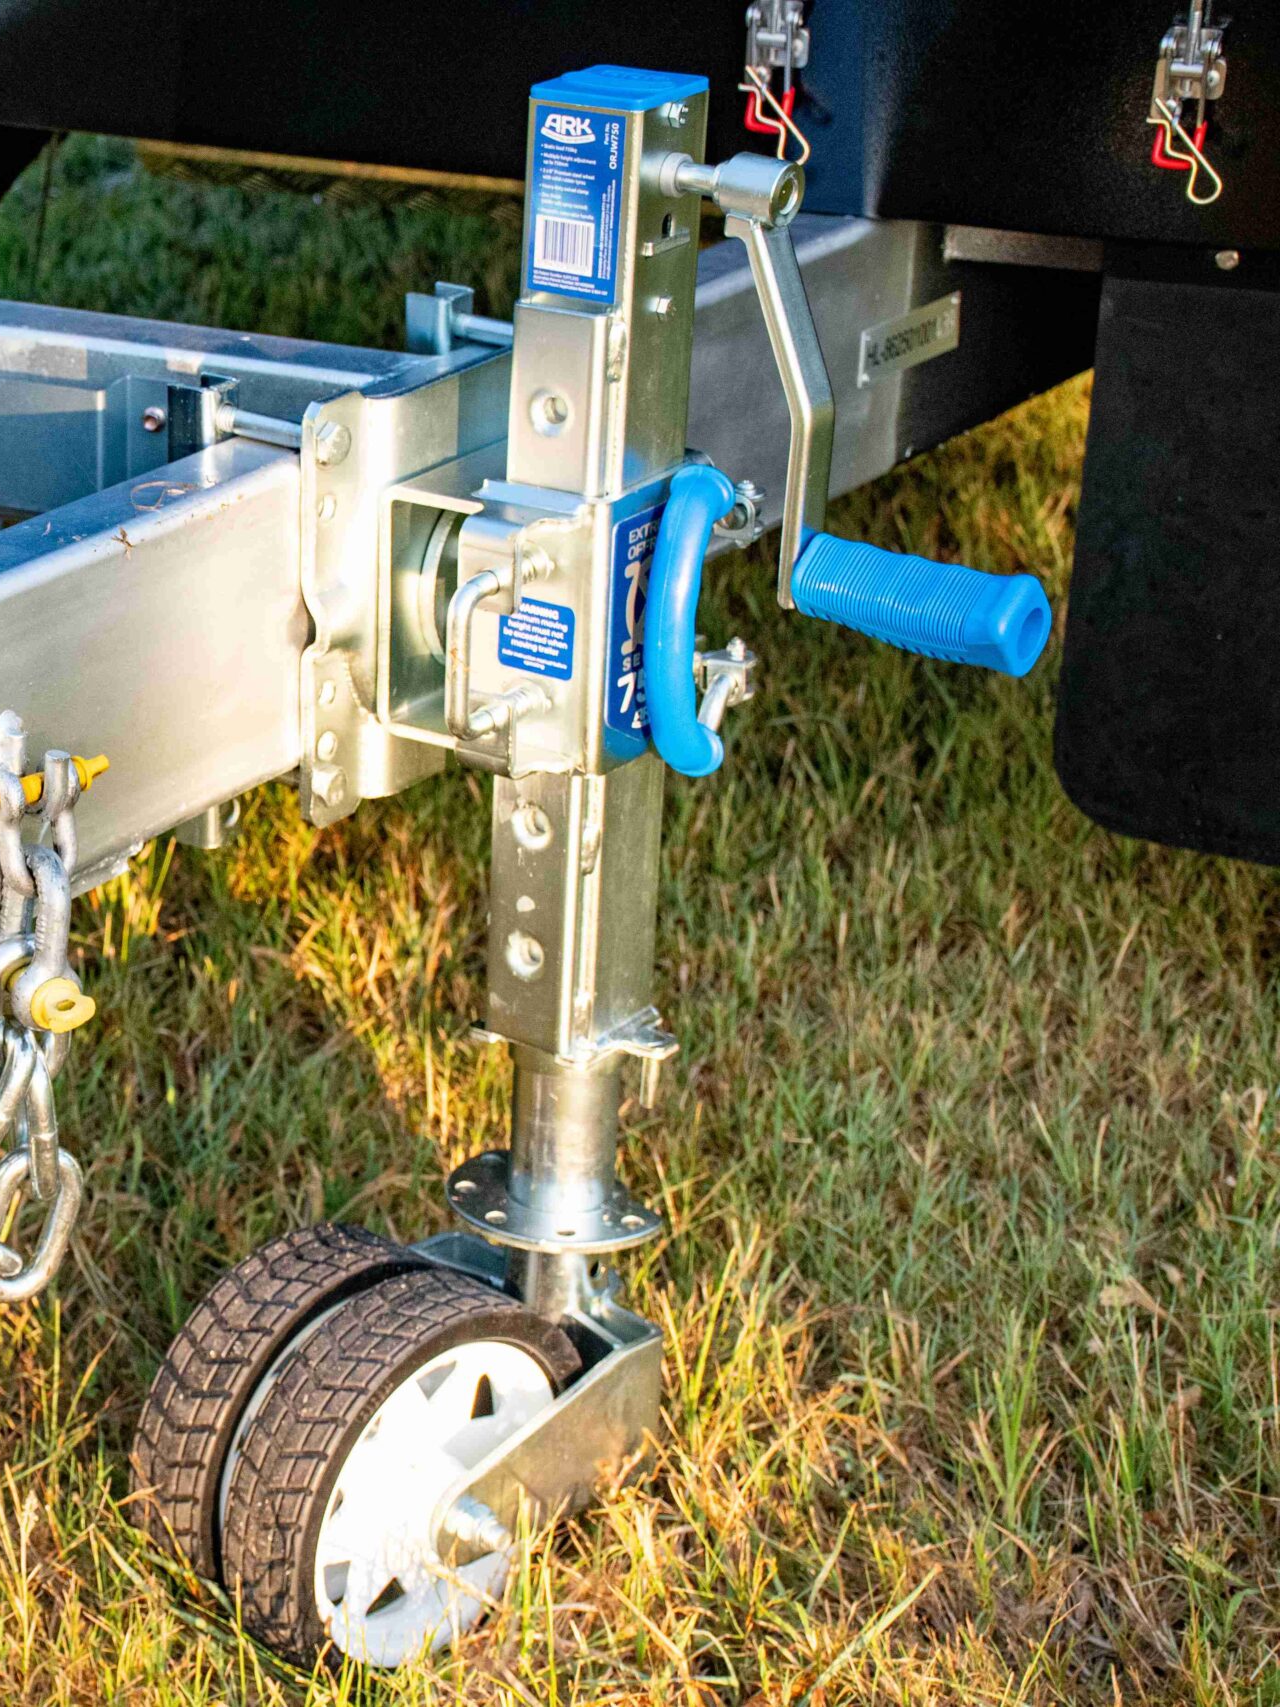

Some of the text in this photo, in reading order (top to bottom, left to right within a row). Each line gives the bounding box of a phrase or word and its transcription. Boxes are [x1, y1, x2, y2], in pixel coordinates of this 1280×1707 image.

[545, 114, 592, 136] ARK
[609, 123, 620, 170] ORJW750
[628, 518, 660, 544] EXTR
[511, 612, 540, 624] imum
[503, 626, 513, 636] be
[547, 638, 568, 650] when
[531, 626, 550, 636] must
[551, 630, 564, 640] not
[622, 652, 641, 672] SE
